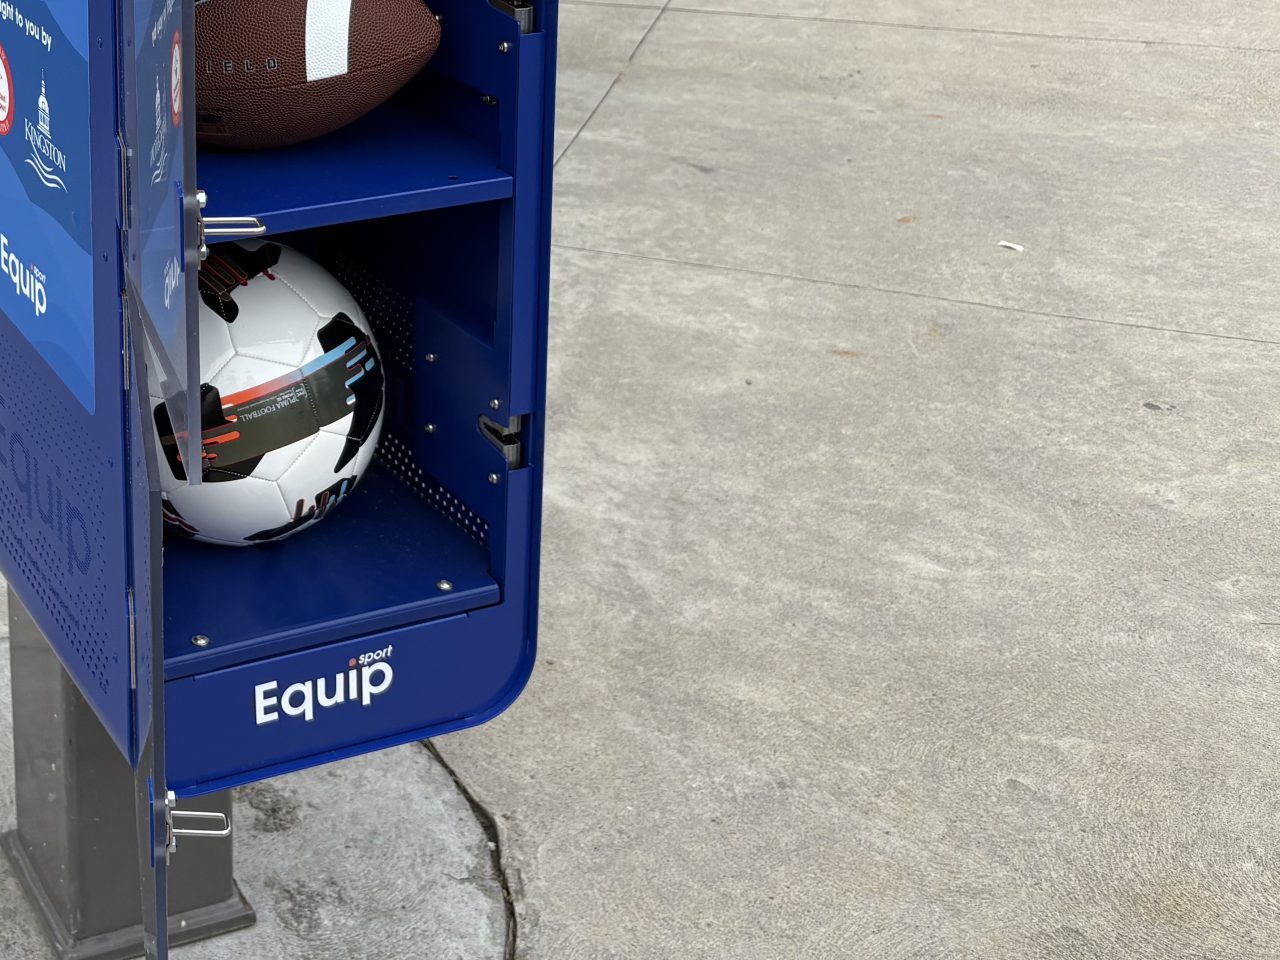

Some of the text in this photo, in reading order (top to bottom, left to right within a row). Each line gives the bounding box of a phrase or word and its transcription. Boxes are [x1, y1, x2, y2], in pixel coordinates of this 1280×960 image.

[15, 7, 24, 28] to
[24, 17, 40, 41] you
[41, 26, 52, 52] by
[205, 57, 278, 74] IELD
[24, 117, 66, 173] KINGSTON
[0, 232, 47, 317] Equip
[33, 265, 46, 284] sport
[239, 404, 276, 422] FOOTBALL
[276, 396, 297, 409] PUMA
[358, 644, 393, 665] sport
[254, 657, 394, 725] Equip
